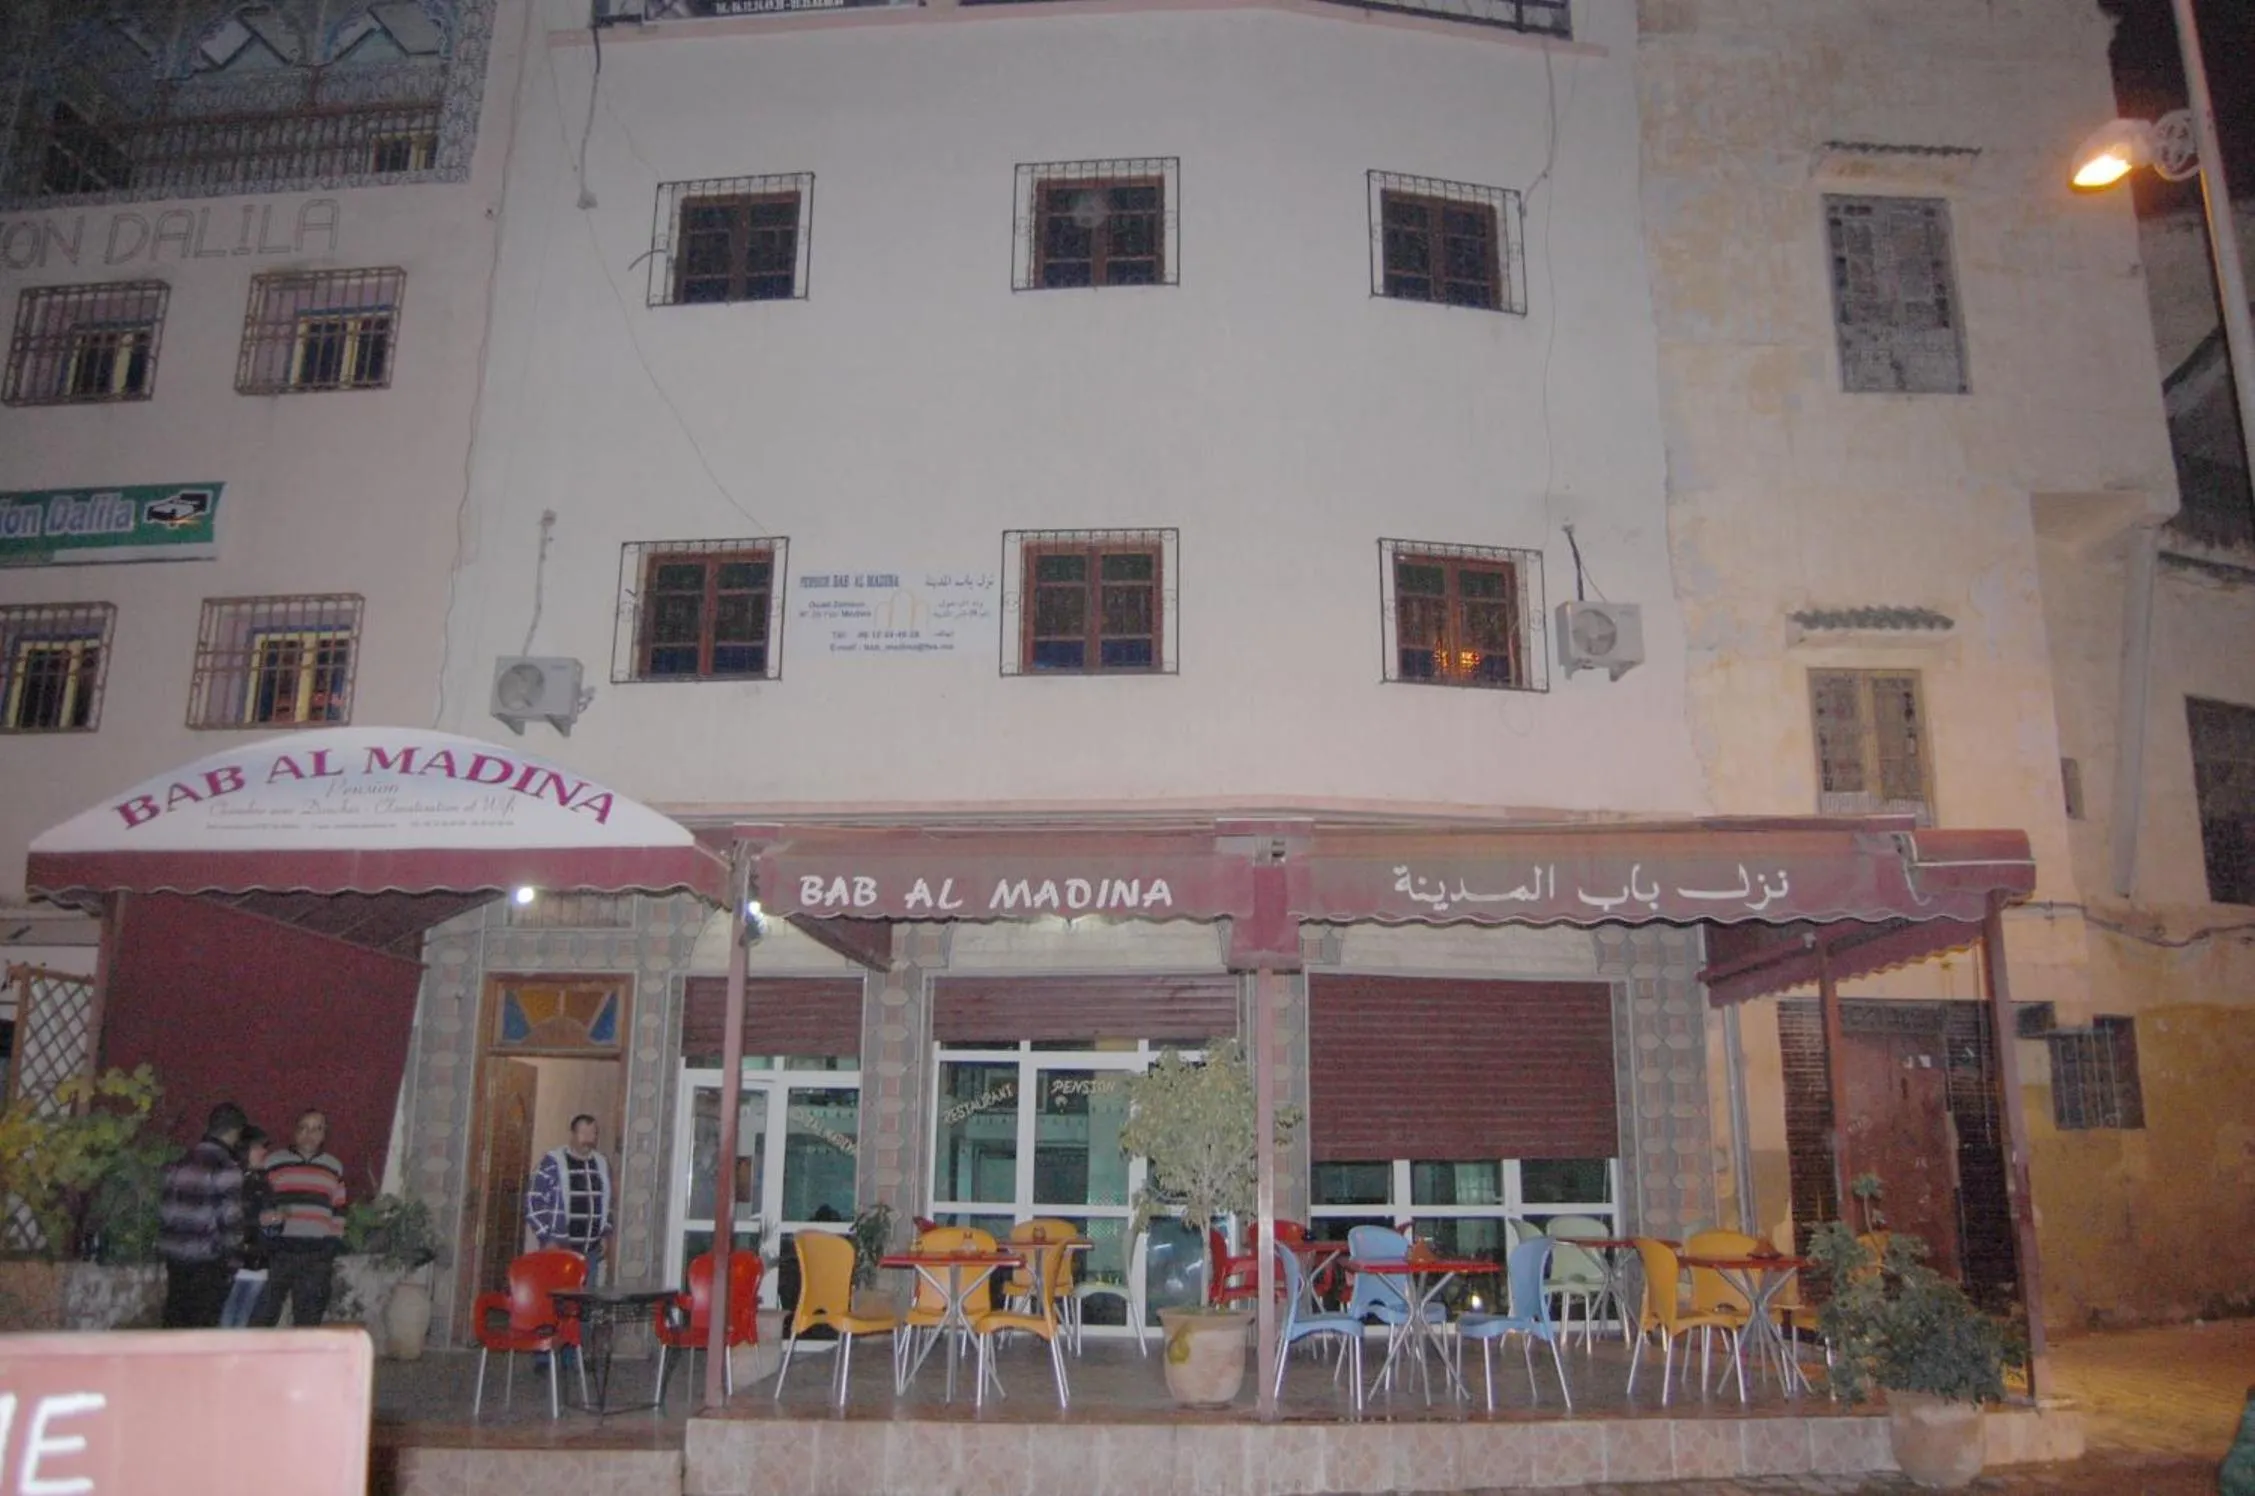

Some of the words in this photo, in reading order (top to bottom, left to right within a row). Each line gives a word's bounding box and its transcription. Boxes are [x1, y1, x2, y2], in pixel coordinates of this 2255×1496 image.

[103, 198, 340, 265] DALILA
[46, 493, 135, 536] Dalila
[112, 765, 246, 829] BAB
[265, 749, 345, 784] AL
[362, 746, 616, 824] MADINA
[325, 777, 399, 797] Pension
[799, 875, 878, 907] BAB
[904, 878, 963, 909] AL
[989, 878, 1173, 909] MADINA
[1393, 863, 1555, 911] المدينة
[1578, 863, 1660, 912] باب
[1677, 863, 1789, 910] نزل
[1051, 1078, 1116, 1095] PENSION
